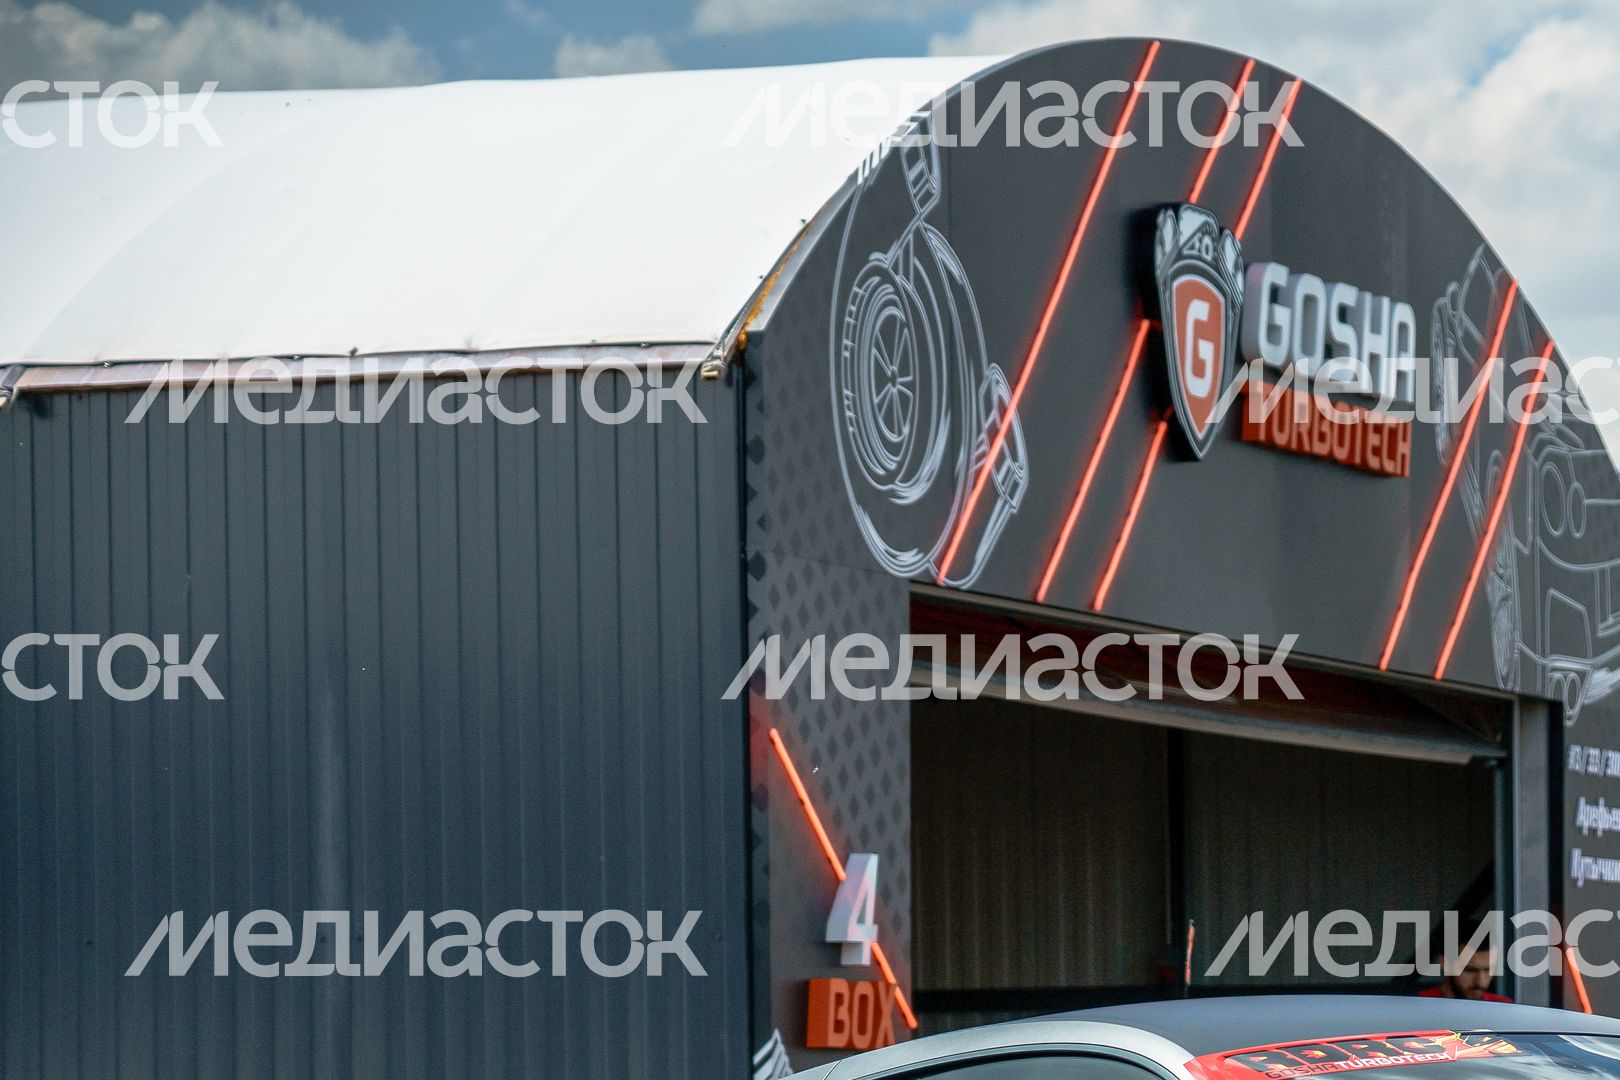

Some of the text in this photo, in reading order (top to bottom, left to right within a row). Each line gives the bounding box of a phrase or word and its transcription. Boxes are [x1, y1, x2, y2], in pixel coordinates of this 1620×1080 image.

[1246, 262, 1416, 403] GOSHA
[831, 853, 878, 965] 4
[828, 978, 897, 1050] BOX
